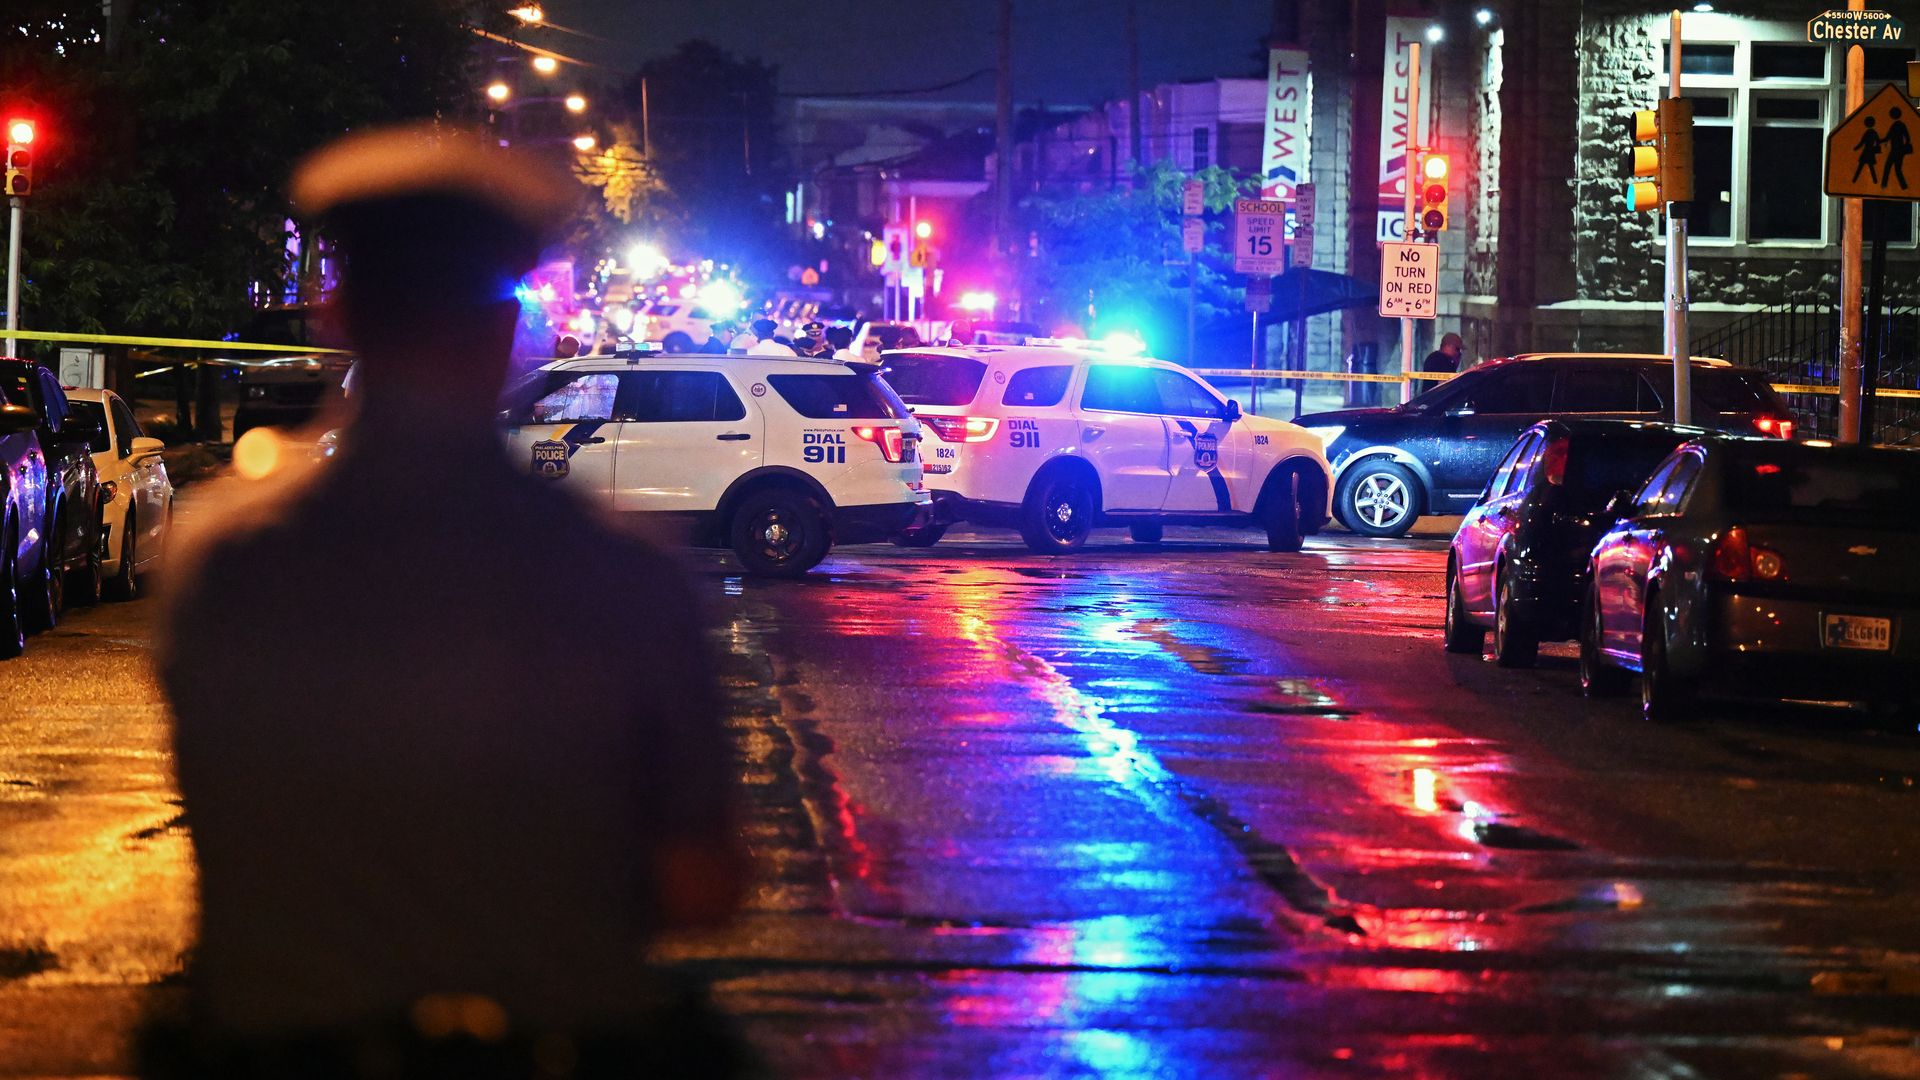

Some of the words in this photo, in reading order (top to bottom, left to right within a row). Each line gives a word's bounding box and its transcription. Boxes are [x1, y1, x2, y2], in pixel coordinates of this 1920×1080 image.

[1813, 21, 1877, 40] Chester
[1882, 23, 1902, 40] Av
[1272, 62, 1300, 160] WEST
[1239, 202, 1282, 213] SCHOOL
[1247, 217, 1275, 225] SPEED
[1247, 235, 1273, 256] 15
[1400, 250, 1420, 262] NO
[1395, 266, 1426, 278] TURN
[1386, 281, 1403, 293] ON
[1408, 283, 1433, 294] RED
[1008, 419, 1039, 430] DIAL
[803, 433, 846, 444] DIAL
[1009, 431, 1041, 448] 911
[1254, 435, 1269, 445] 1824
[535, 450, 565, 461] POLICE
[803, 445, 846, 464] 911
[936, 448, 955, 459] 1824
